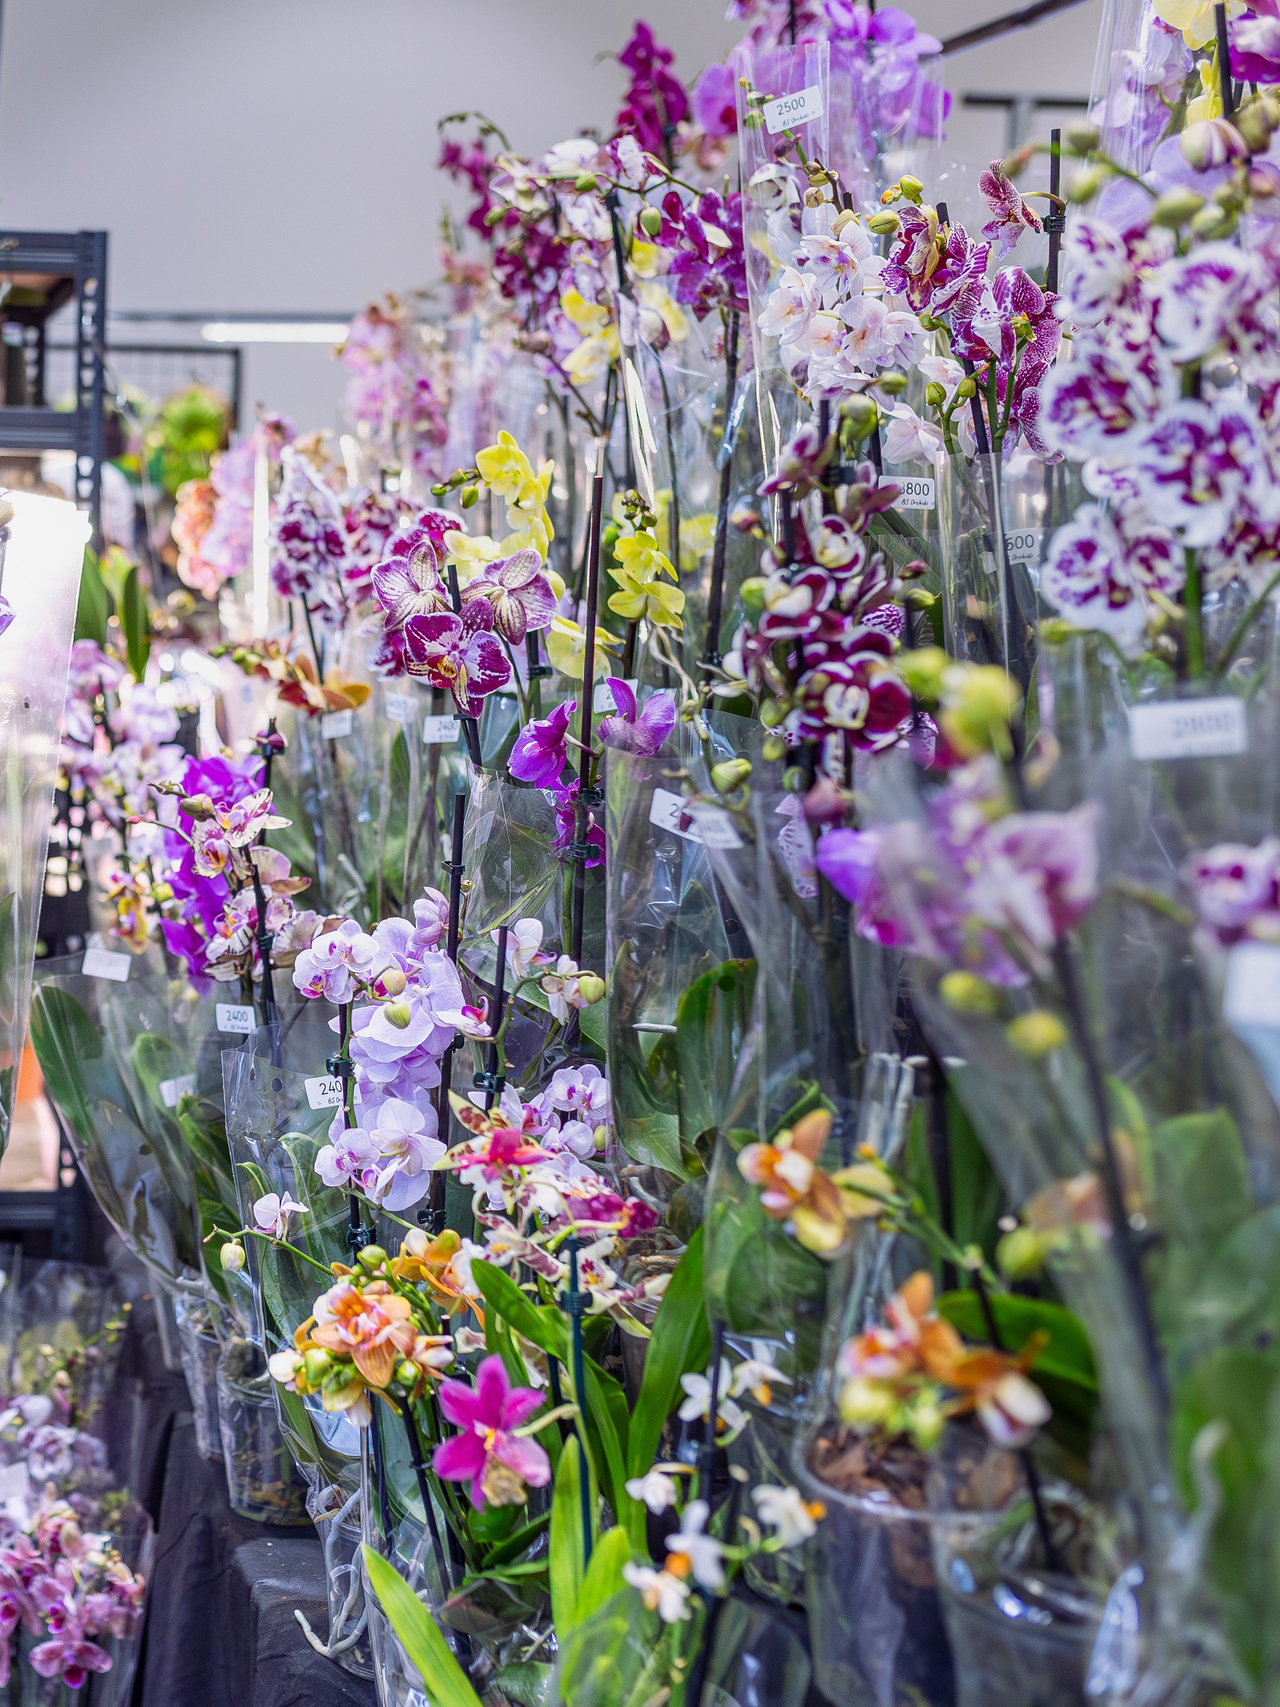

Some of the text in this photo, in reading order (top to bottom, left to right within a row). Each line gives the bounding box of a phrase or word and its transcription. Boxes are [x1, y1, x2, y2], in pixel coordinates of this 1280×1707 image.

[776, 96, 806, 116] 2500
[901, 498, 910, 506] BS
[1005, 534, 1035, 551] 500
[226, 1010, 248, 1022] 2400
[319, 1080, 343, 1095] 240
